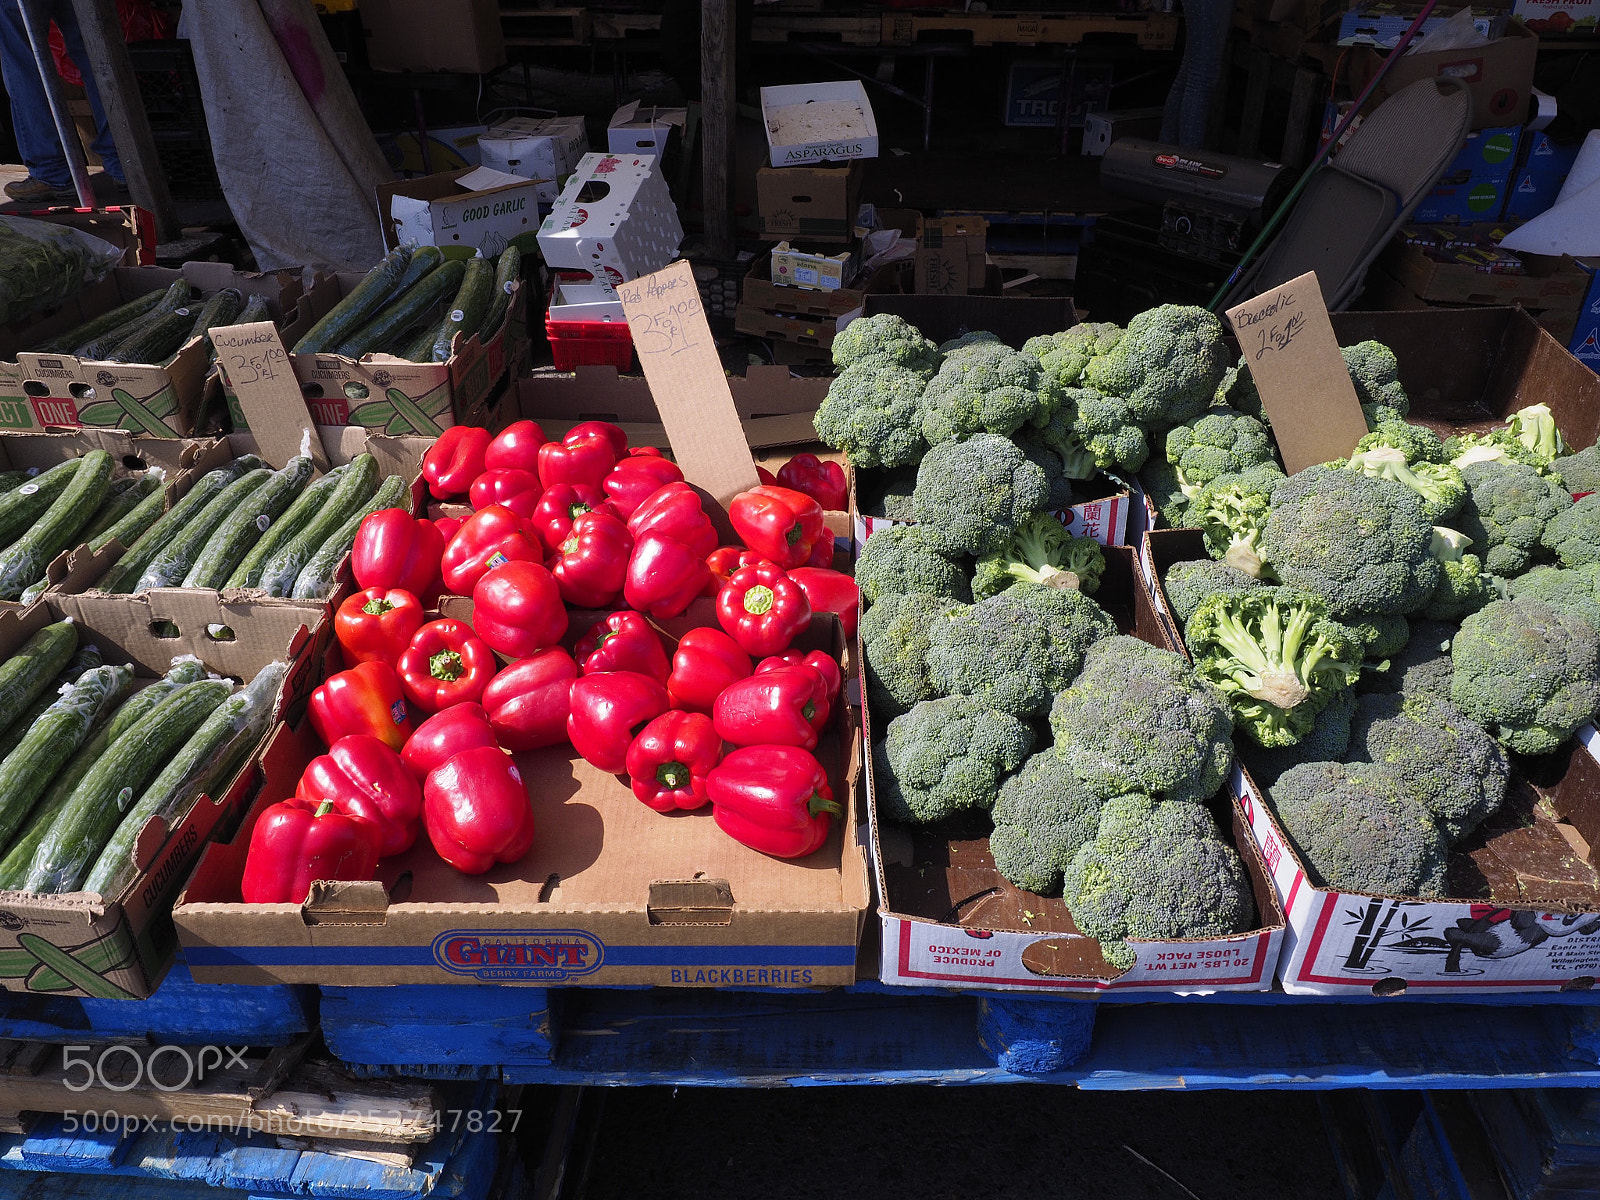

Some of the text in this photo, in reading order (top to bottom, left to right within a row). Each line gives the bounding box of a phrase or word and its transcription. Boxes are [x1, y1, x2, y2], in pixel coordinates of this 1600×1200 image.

[785, 143, 863, 160] ASPARAGUS
[463, 197, 526, 222] GOOD GARLIC
[929, 257, 938, 289] FRESH
[631, 313, 673, 354] 3
[1255, 328, 1274, 360] 2
[231, 355, 259, 384] 3
[311, 370, 350, 380] CUCUMBERS
[38, 402, 76, 425] ONE
[313, 403, 344, 426] ONE
[1081, 504, 1102, 538] 蘭花
[142, 823, 199, 909] CUCUMBERS
[445, 936, 589, 967] GIANT
[929, 945, 1002, 958] OF MEXICO
[933, 955, 995, 967] PRODUCE
[1157, 948, 1240, 960] LOOSE PACK
[1144, 963, 1167, 971] WT.
[1170, 962, 1197, 970] NET
[1233, 958, 1249, 967] 20
[483, 970, 563, 978] BERRY FARMS
[671, 969, 813, 983] BLACKBERRIES
